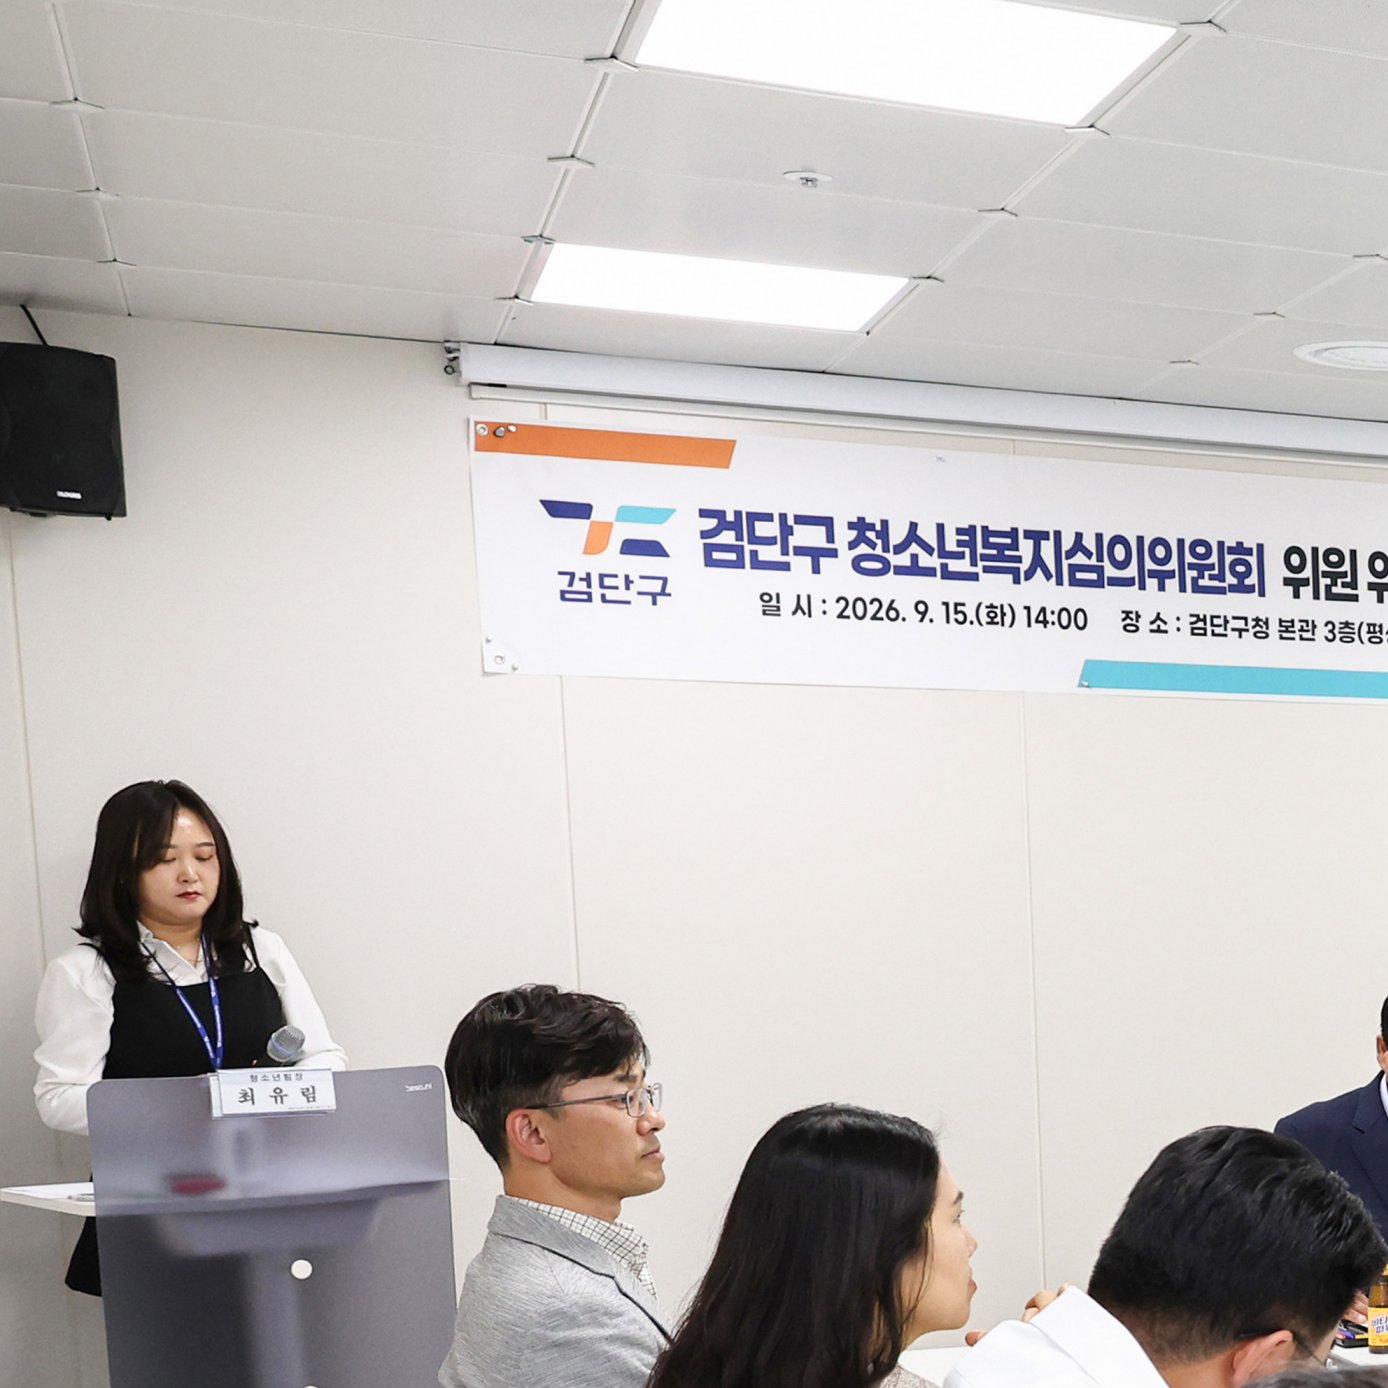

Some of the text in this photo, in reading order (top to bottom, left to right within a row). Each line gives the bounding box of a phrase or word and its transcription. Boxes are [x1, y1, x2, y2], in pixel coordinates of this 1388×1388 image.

[699, 508, 839, 575] 검단구
[847, 516, 1266, 598] 청소년복지심의위원회
[1282, 545, 1360, 603] 위원
[557, 571, 672, 606] 검단구
[835, 596, 907, 622] 2026.
[914, 599, 934, 624] 9.
[941, 601, 1016, 629] 15.(화)
[1023, 605, 1088, 631] 14:00
[1188, 613, 1270, 640] 검단구청
[1277, 617, 1318, 642] 본관
